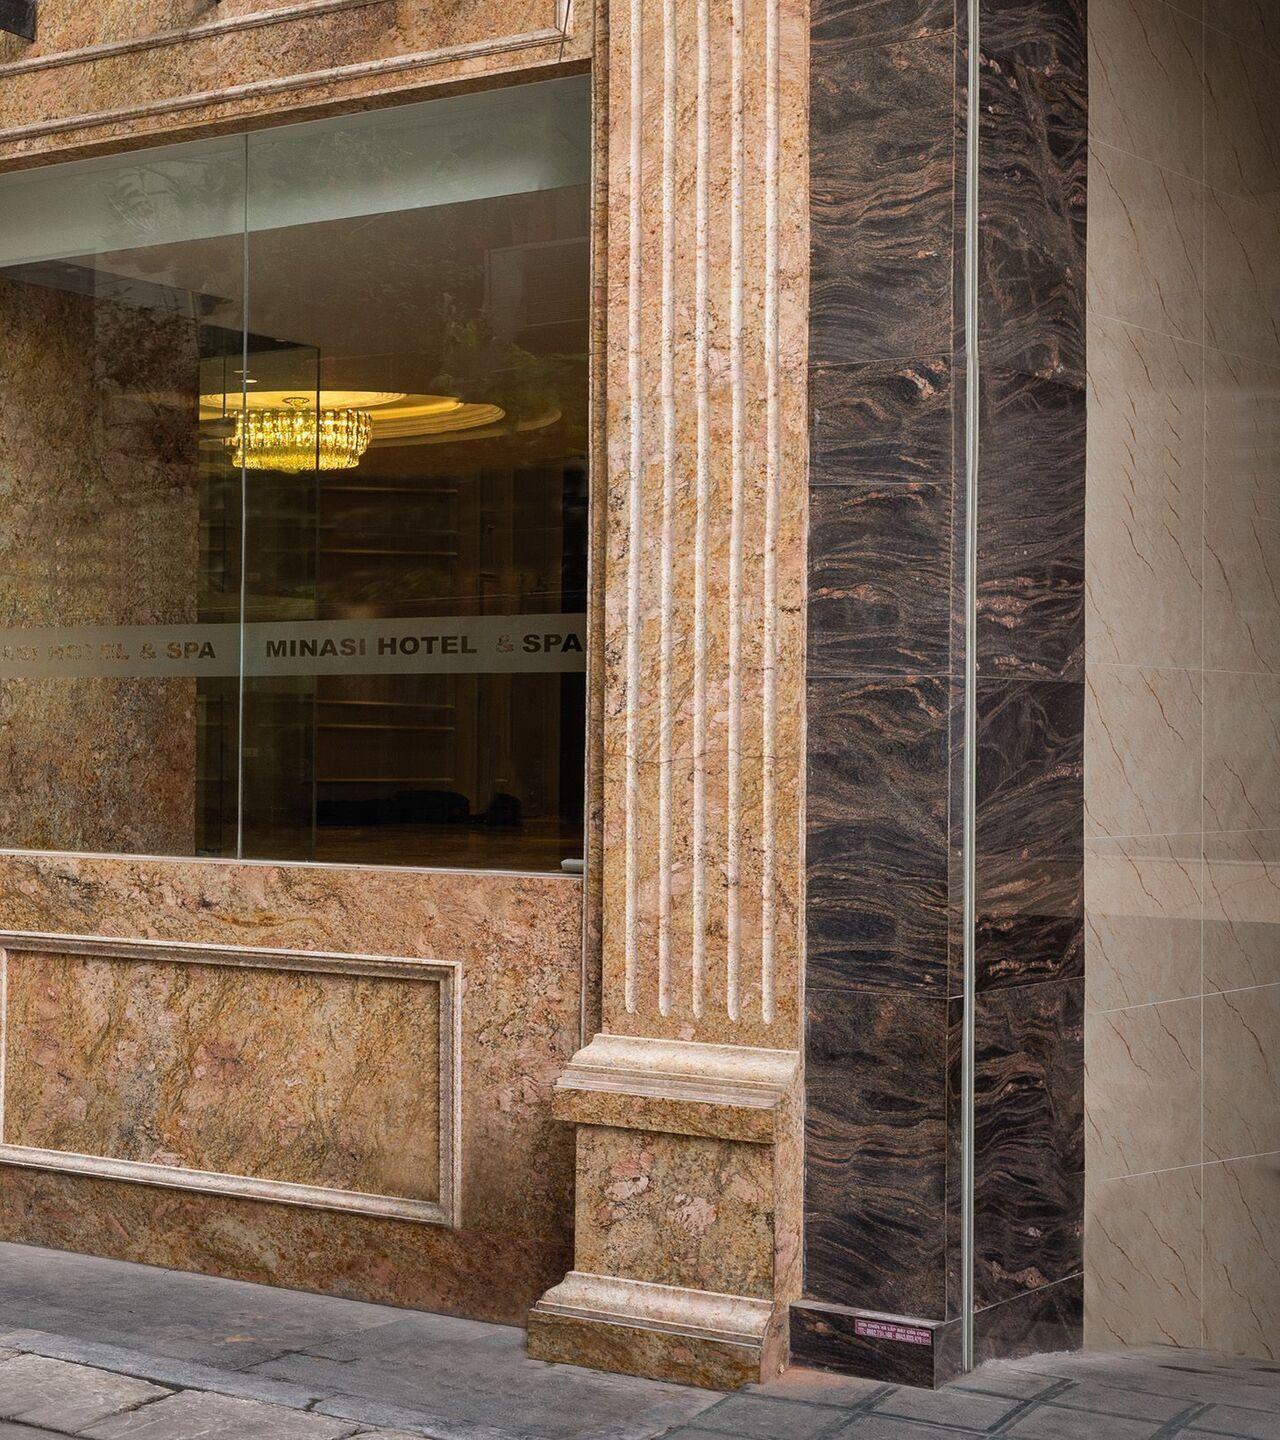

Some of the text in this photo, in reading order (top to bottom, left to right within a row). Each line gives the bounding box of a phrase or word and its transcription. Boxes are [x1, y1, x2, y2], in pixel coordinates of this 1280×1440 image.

[166, 641, 216, 659] SPA
[266, 638, 366, 658] MINASI
[378, 635, 477, 656] HOTEL
[522, 632, 584, 653] SPA
